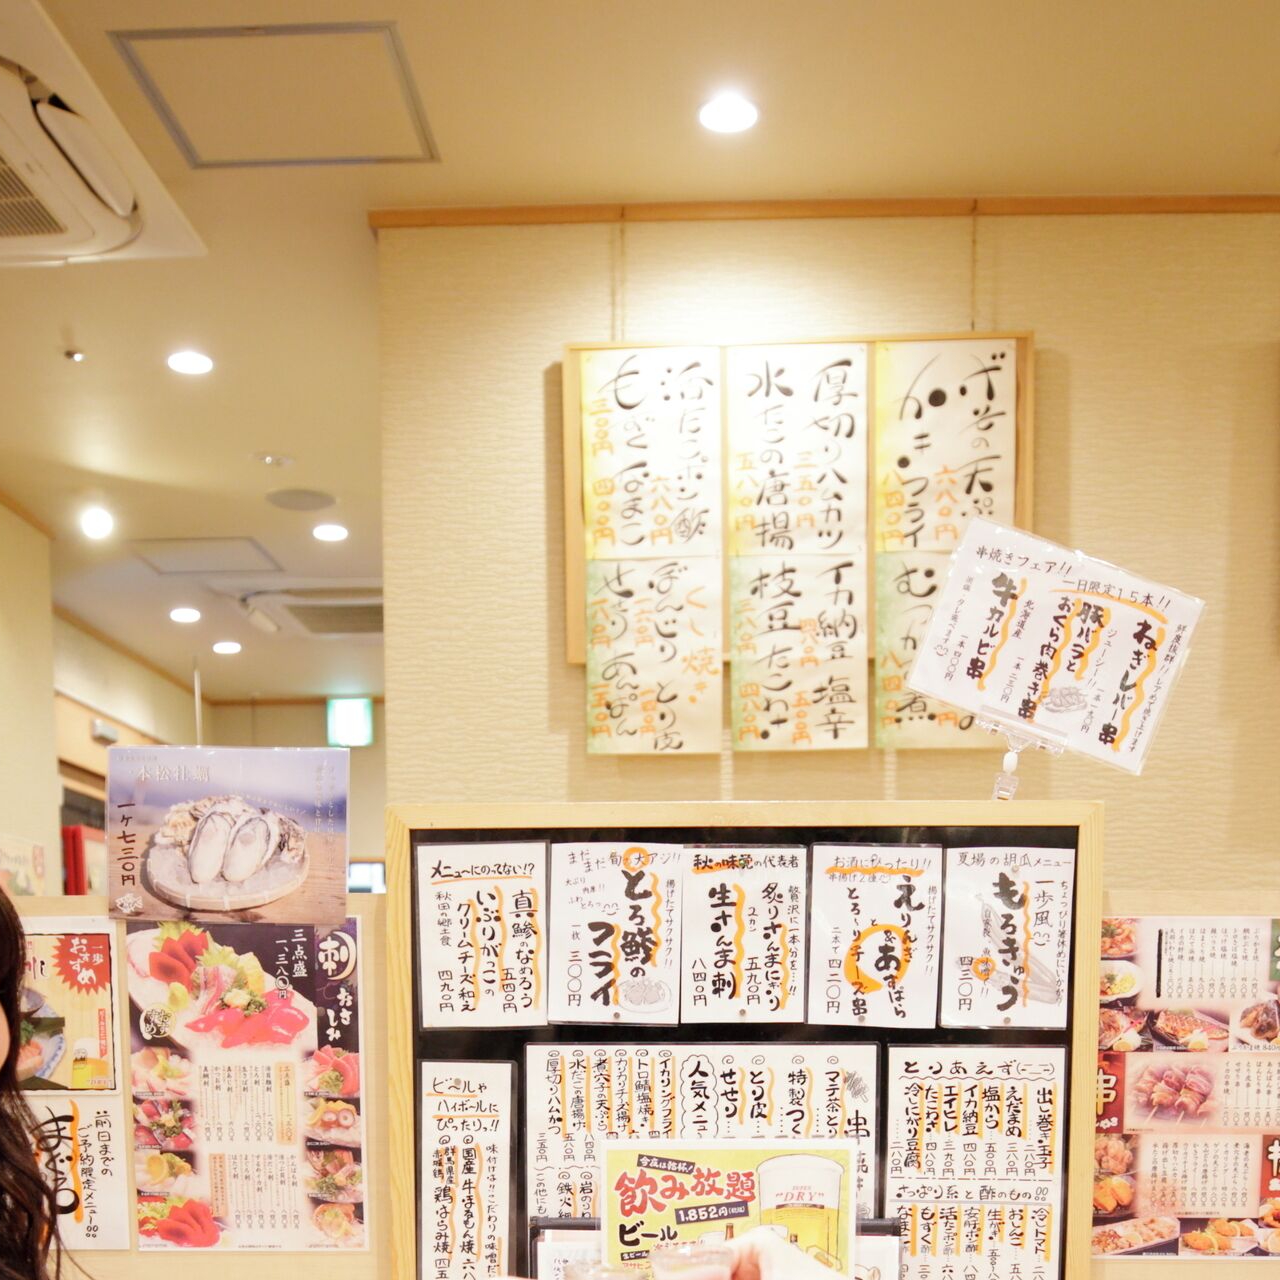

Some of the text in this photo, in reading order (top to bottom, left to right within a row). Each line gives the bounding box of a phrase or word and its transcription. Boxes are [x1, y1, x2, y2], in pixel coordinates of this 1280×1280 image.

[745, 359, 795, 551] 水たこの唐揚
[803, 359, 859, 550] 厚切りハムカツ
[749, 560, 803, 637] 枝豆
[966, 572, 1019, 680] 牛カルビ串
[812, 674, 857, 740] 塩辛
[1098, 618, 1158, 746] ねぎレバー串
[693, 853, 801, 871] 秋の味覚の代表者
[434, 891, 453, 947] 秋田の郷土食
[1033, 878, 1055, 928] 一歩風
[291, 928, 308, 978] 三点盛
[318, 930, 357, 981] 刺
[457, 902, 477, 1013] クリームチーズ和え
[476, 889, 503, 997] いぶりがっこの
[587, 921, 617, 1007] フライ
[707, 882, 737, 1000] 生さんま刺
[992, 872, 1027, 1012] もろきゅう
[720, 1068, 740, 1119] せせり
[904, 1060, 1016, 1076] とりあえず
[749, 1070, 768, 1119] とり皮
[943, 1085, 959, 1132] エイヒレ
[962, 1084, 980, 1136] イカ納豆
[982, 1085, 1001, 1130] 塩から
[1005, 1085, 1023, 1138] えだまめ
[903, 1082, 923, 1168] 冷しにがり豆腐
[614, 1168, 757, 1217] 飲み放題
[619, 1220, 678, 1247] ビール
[1008, 1208, 1024, 1246] おしんこ
[1031, 1207, 1050, 1254] 冷しトマト
